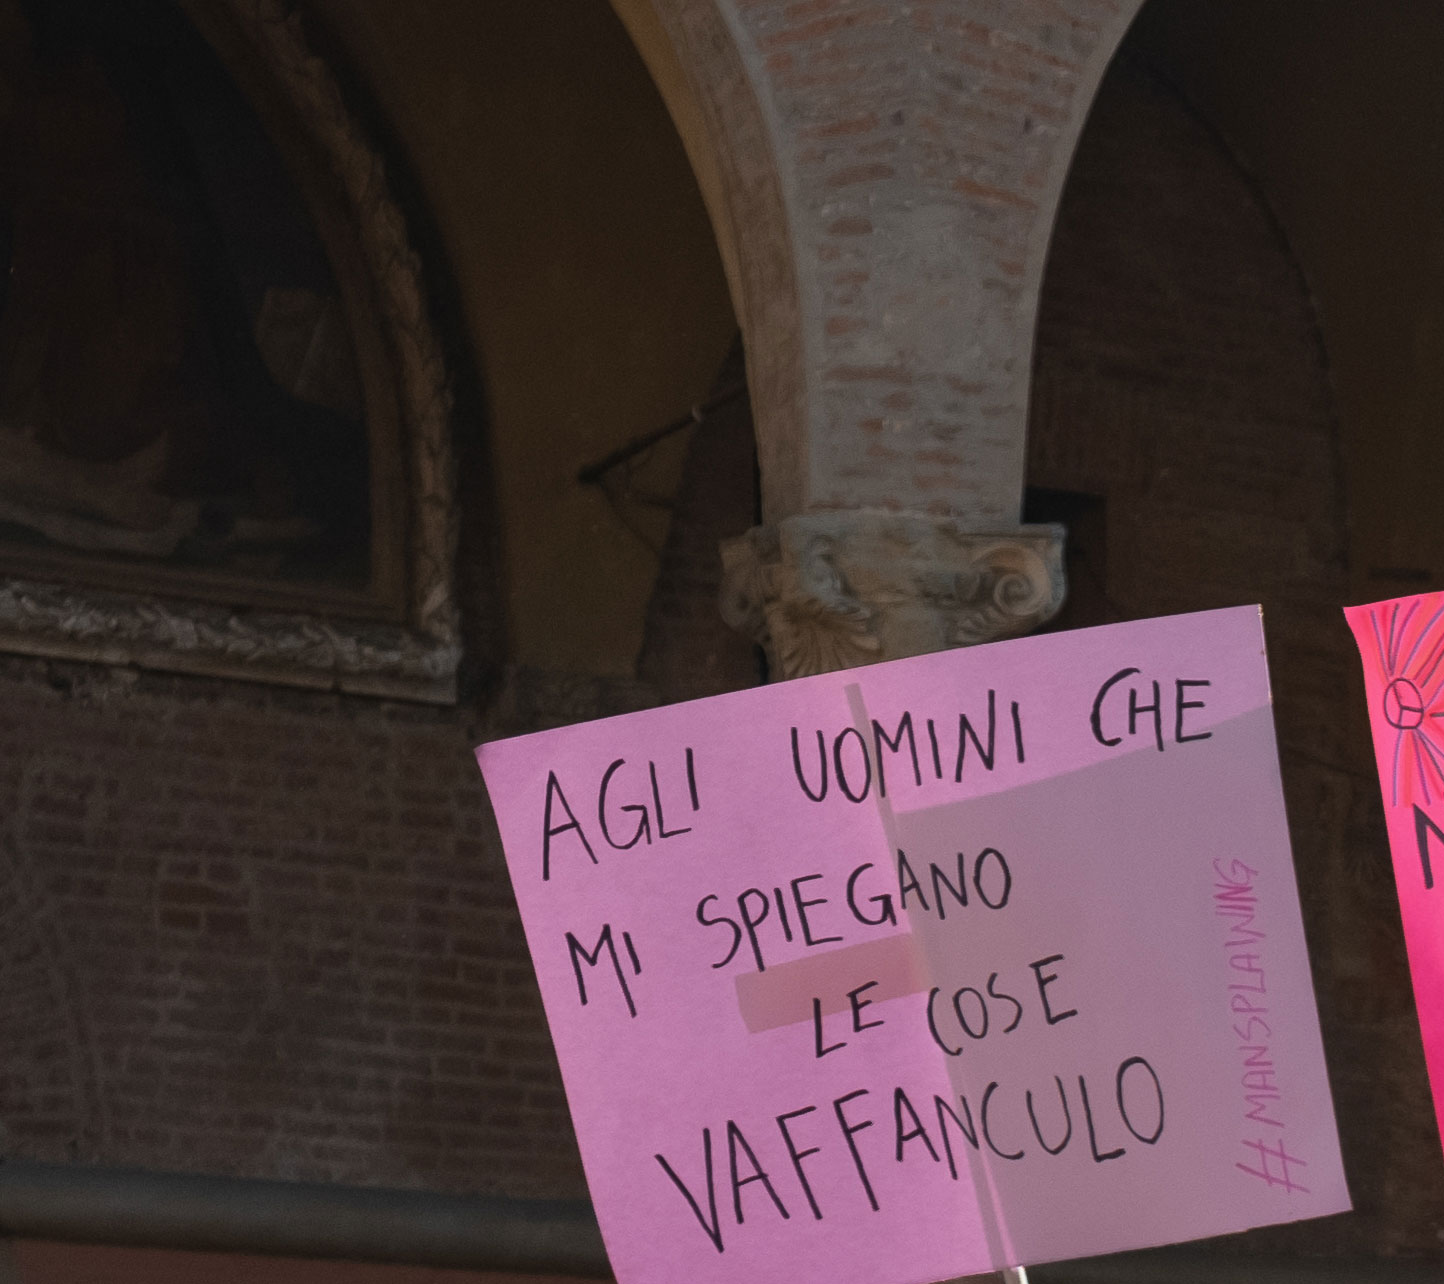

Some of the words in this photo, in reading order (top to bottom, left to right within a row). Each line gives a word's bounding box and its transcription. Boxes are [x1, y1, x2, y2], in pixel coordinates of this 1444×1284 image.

[543, 747, 700, 880] AGLI
[791, 689, 1024, 803] UOMINI
[1091, 667, 1213, 752] CHE
[566, 923, 641, 1018] MI
[696, 847, 1012, 971] SPIEGANO
[813, 981, 885, 1058] LE
[927, 954, 1078, 1056] COSE
[655, 1056, 1166, 1253] VAFFANCULO
